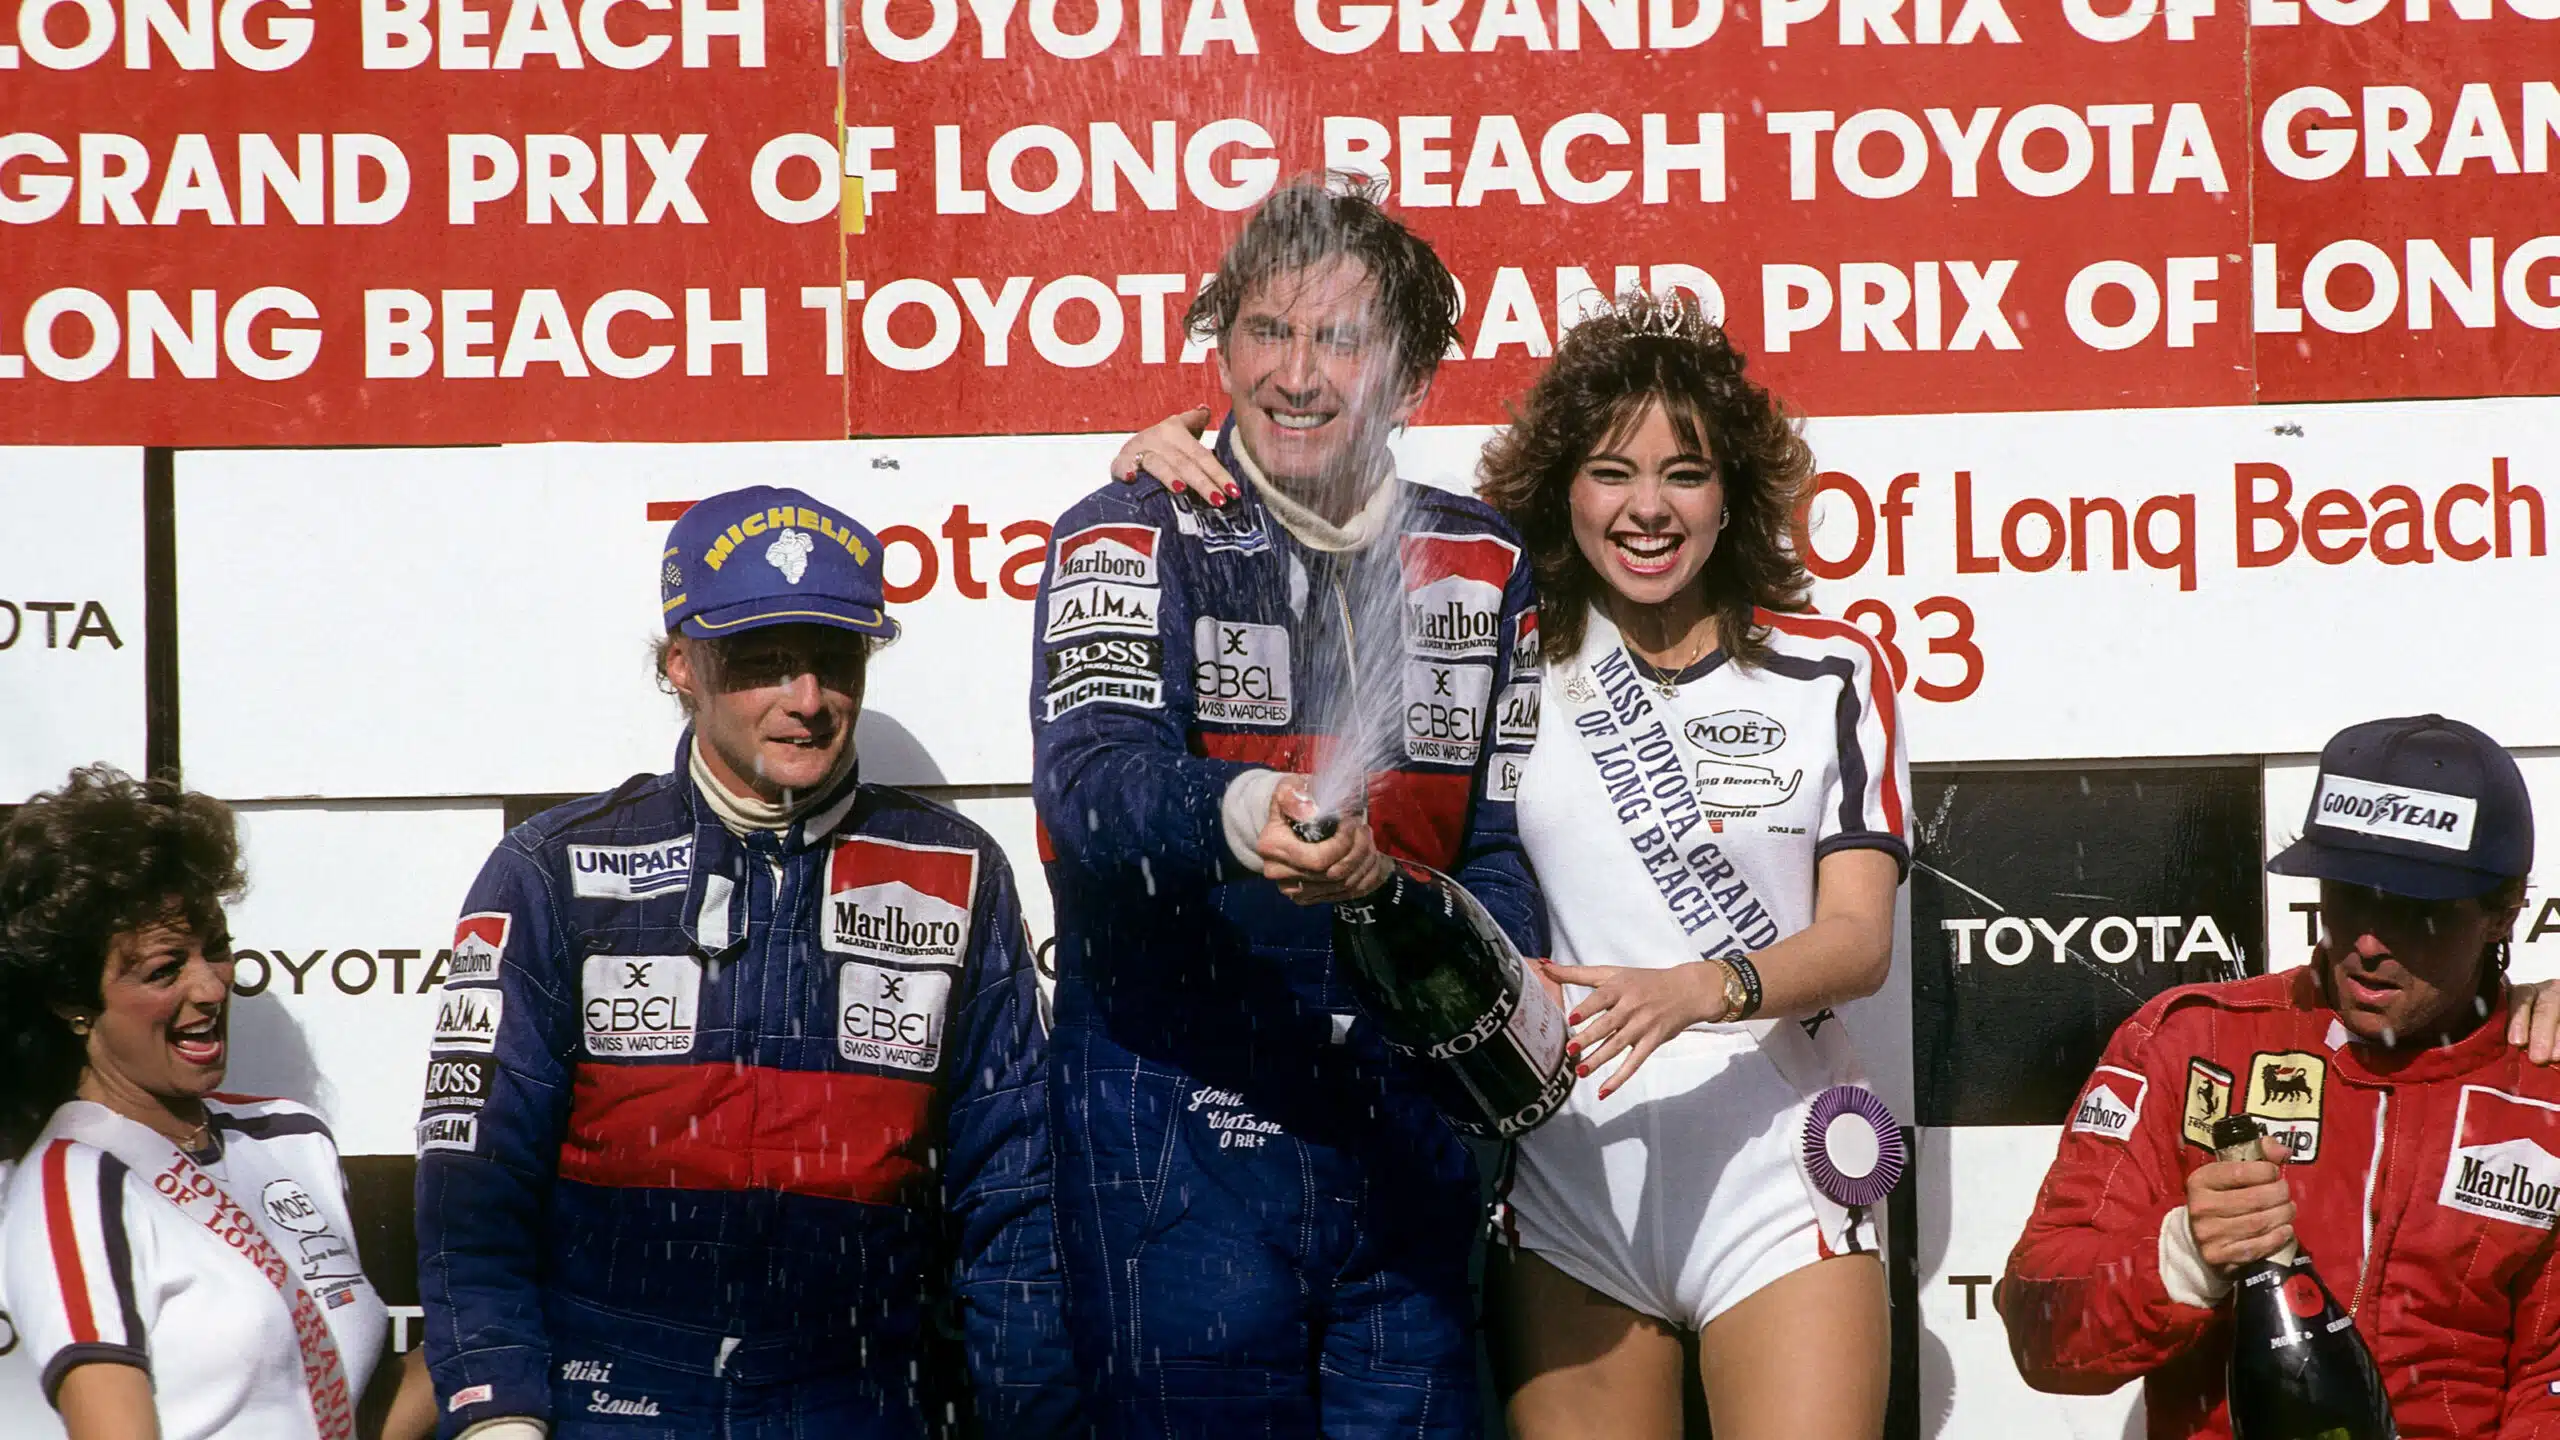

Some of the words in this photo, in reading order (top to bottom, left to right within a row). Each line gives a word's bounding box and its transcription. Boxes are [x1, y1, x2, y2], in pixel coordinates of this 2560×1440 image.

[0, 0, 316, 71] ONG
[362, 0, 768, 70] BEACH
[1294, 0, 1719, 55] GRAND
[0, 132, 411, 226] GRAND
[448, 134, 709, 224] PRIX
[750, 126, 896, 224] OF
[934, 118, 1280, 215] LONG
[1323, 112, 1725, 207] BEACH
[1767, 103, 2229, 201] TOYOTA
[364, 288, 768, 380] BEACH
[1762, 260, 2024, 353] PRIX
[2065, 257, 2219, 350] OF
[2254, 236, 2560, 333] LONG
[1792, 471, 1920, 580] Of
[2234, 457, 2548, 569] Beach
[704, 506, 871, 572] MICHELIN
[1060, 551, 1146, 580] Marlboro
[1404, 602, 1498, 641] Marlbor
[1057, 641, 1150, 673] BOSS
[1196, 661, 1286, 700] EBEL
[1054, 682, 1155, 717] MICHELIN
[1197, 701, 1226, 717] WISS
[1229, 705, 1287, 721] WATCHES
[1407, 703, 1480, 742] EBEL
[1575, 709, 1619, 738] OF
[1691, 722, 1779, 745] MOËT
[1409, 742, 1440, 757] SWISS
[1591, 743, 1653, 825] LONG
[1723, 776, 1771, 785] Beach
[1591, 647, 1653, 726] MISS
[1631, 721, 1702, 843] TOYOTA
[1687, 842, 1779, 951] GRAND
[1630, 822, 1720, 936] BEACH
[833, 902, 960, 948] Marlboro
[1941, 916, 2236, 965] TOYOTA
[880, 942, 956, 957] INTERNATIONAL
[231, 948, 453, 997] OYOTA
[586, 997, 691, 1042] EBEL
[843, 1003, 938, 1049] EBEL
[590, 1037, 622, 1051] SWISS
[626, 1035, 690, 1051] WATCHES
[844, 1041, 881, 1060] SWISS
[427, 1063, 482, 1093] BOSS
[1188, 1086, 1245, 1111] John
[1207, 1110, 1283, 1135] Watson
[154, 1173, 198, 1206] OF
[562, 1360, 613, 1383] Niki
[587, 1390, 661, 1417] Lauda
